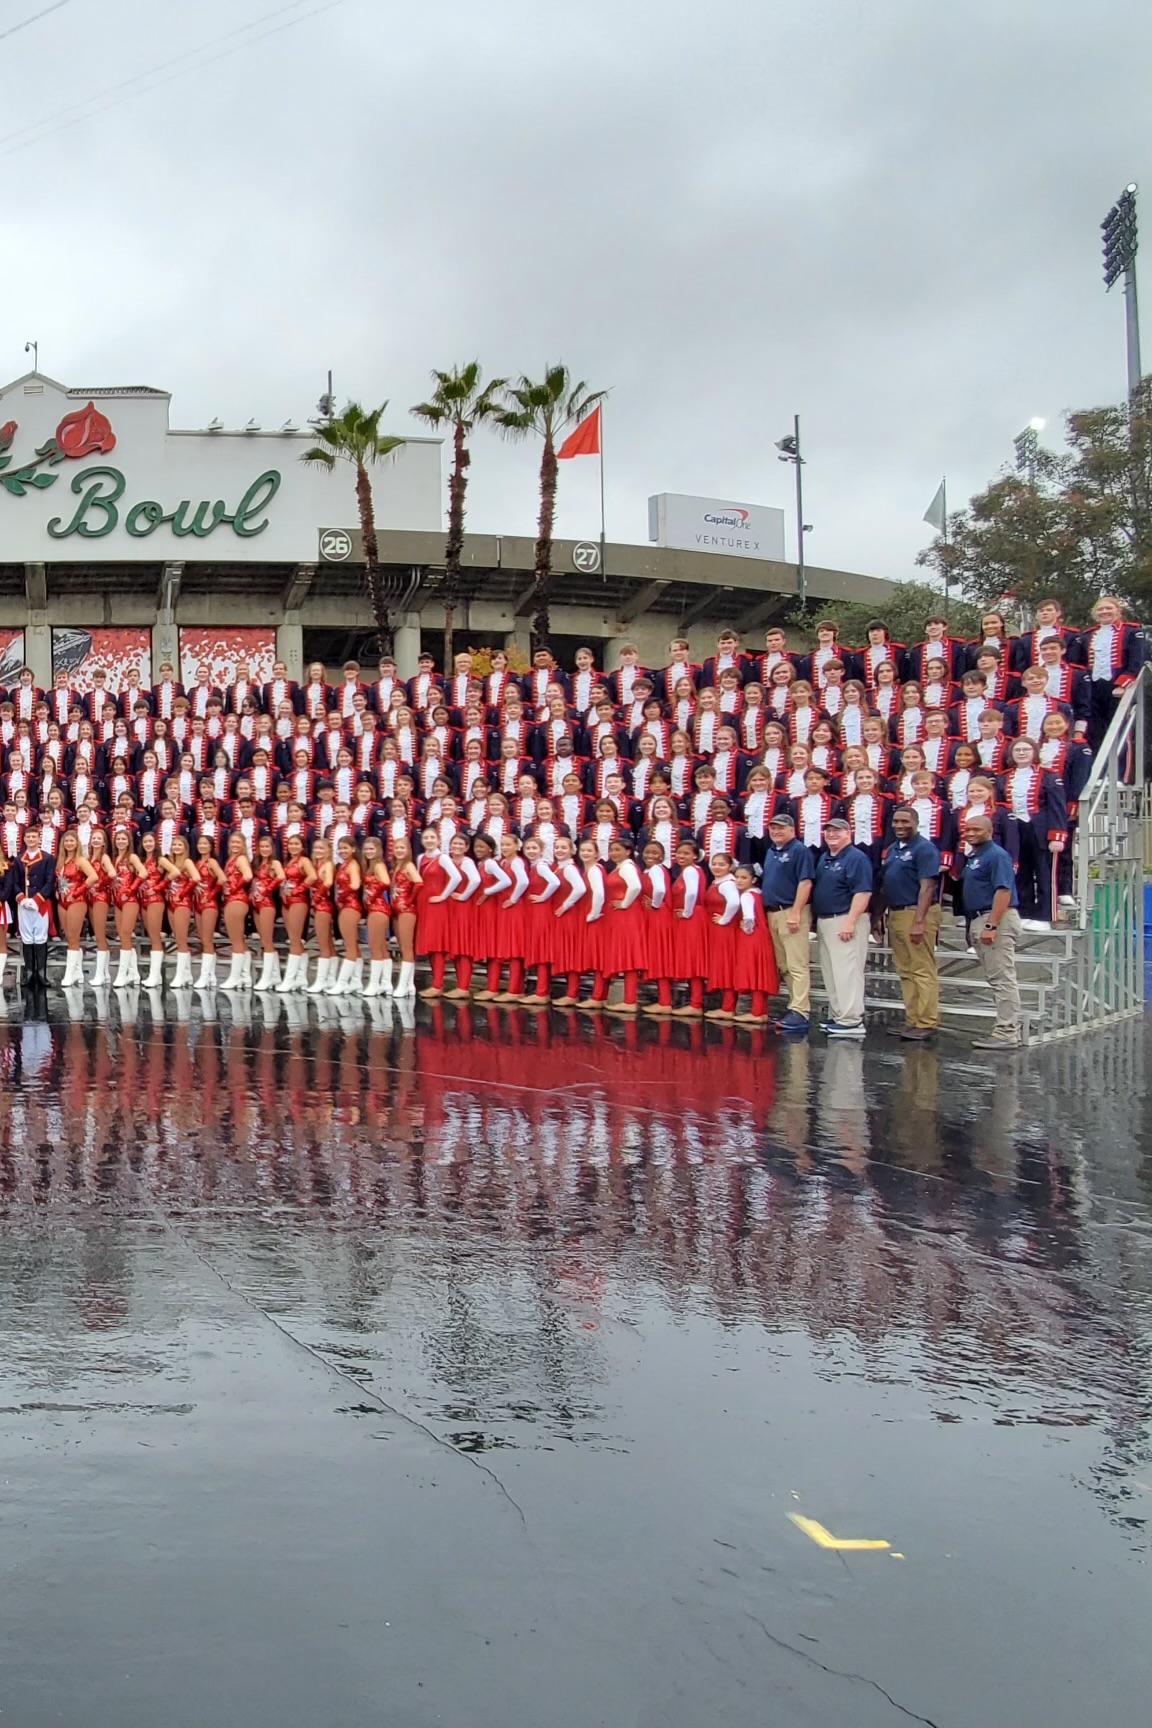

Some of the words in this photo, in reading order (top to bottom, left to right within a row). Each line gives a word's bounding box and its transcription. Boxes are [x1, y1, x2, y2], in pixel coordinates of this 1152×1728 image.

[47, 466, 282, 538] Bowl
[324, 536, 348, 554] 26
[695, 534, 751, 550] VENTURE
[753, 542, 760, 550] X
[576, 548, 597, 566] 27
